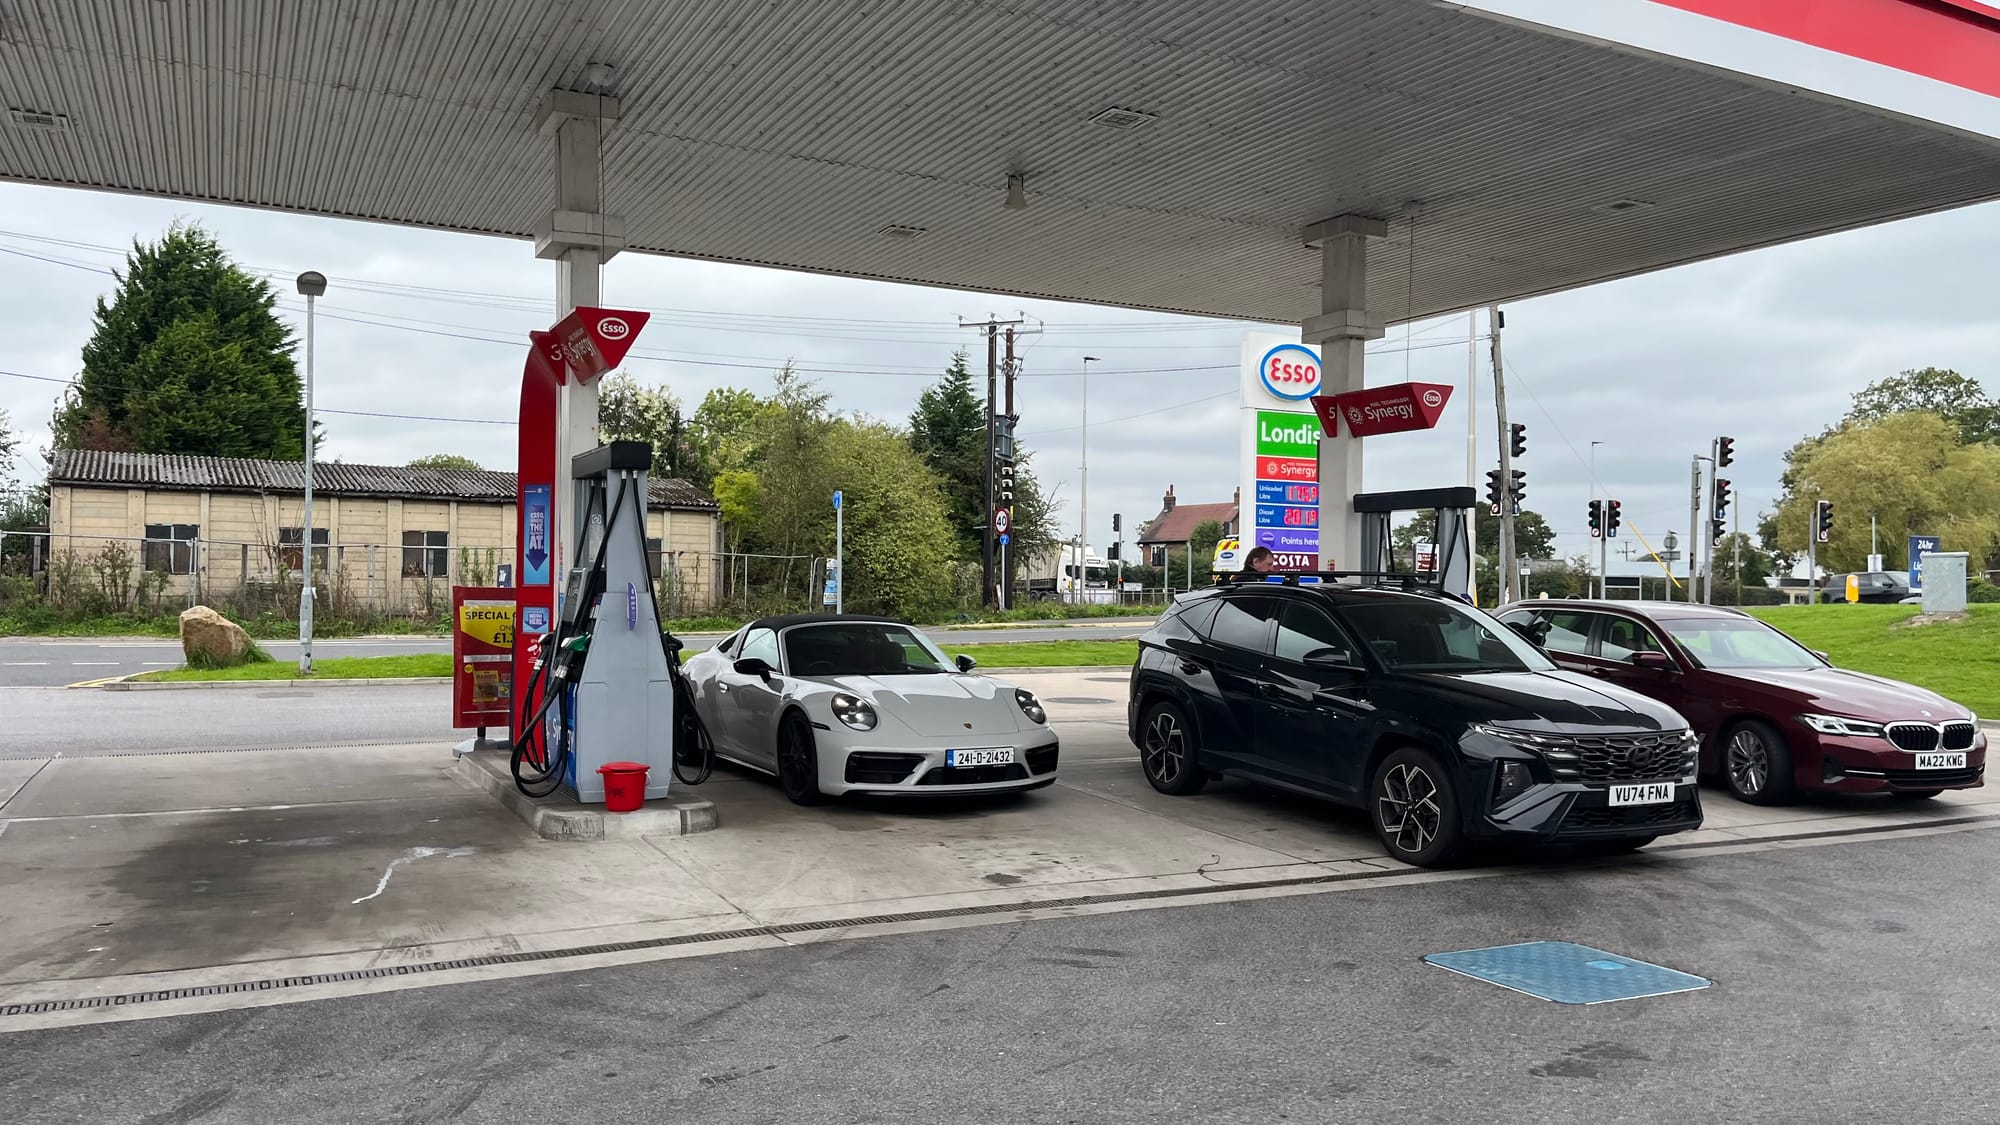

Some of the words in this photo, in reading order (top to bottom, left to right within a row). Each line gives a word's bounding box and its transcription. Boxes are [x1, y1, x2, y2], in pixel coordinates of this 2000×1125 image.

[602, 323, 624, 333] Esso
[551, 344, 562, 360] 3
[1271, 358, 1316, 384] Esso
[1426, 394, 1439, 402] Esso
[1329, 407, 1336, 419] 5
[1364, 404, 1413, 422] Synergy
[1261, 421, 1320, 444] Londis
[1281, 464, 1316, 478] Synergy
[997, 516, 1007, 526] 40
[1281, 537, 1303, 545] Points
[1304, 538, 1319, 546] here
[1917, 539, 1935, 550] 24hr
[465, 611, 510, 620] SPECIAL
[958, 751, 1010, 764] 241-D-21432
[1919, 755, 1944, 767] MA22
[1946, 755, 1963, 766] KWG
[1616, 787, 1645, 802] VU74
[1648, 785, 1669, 800] FNA
